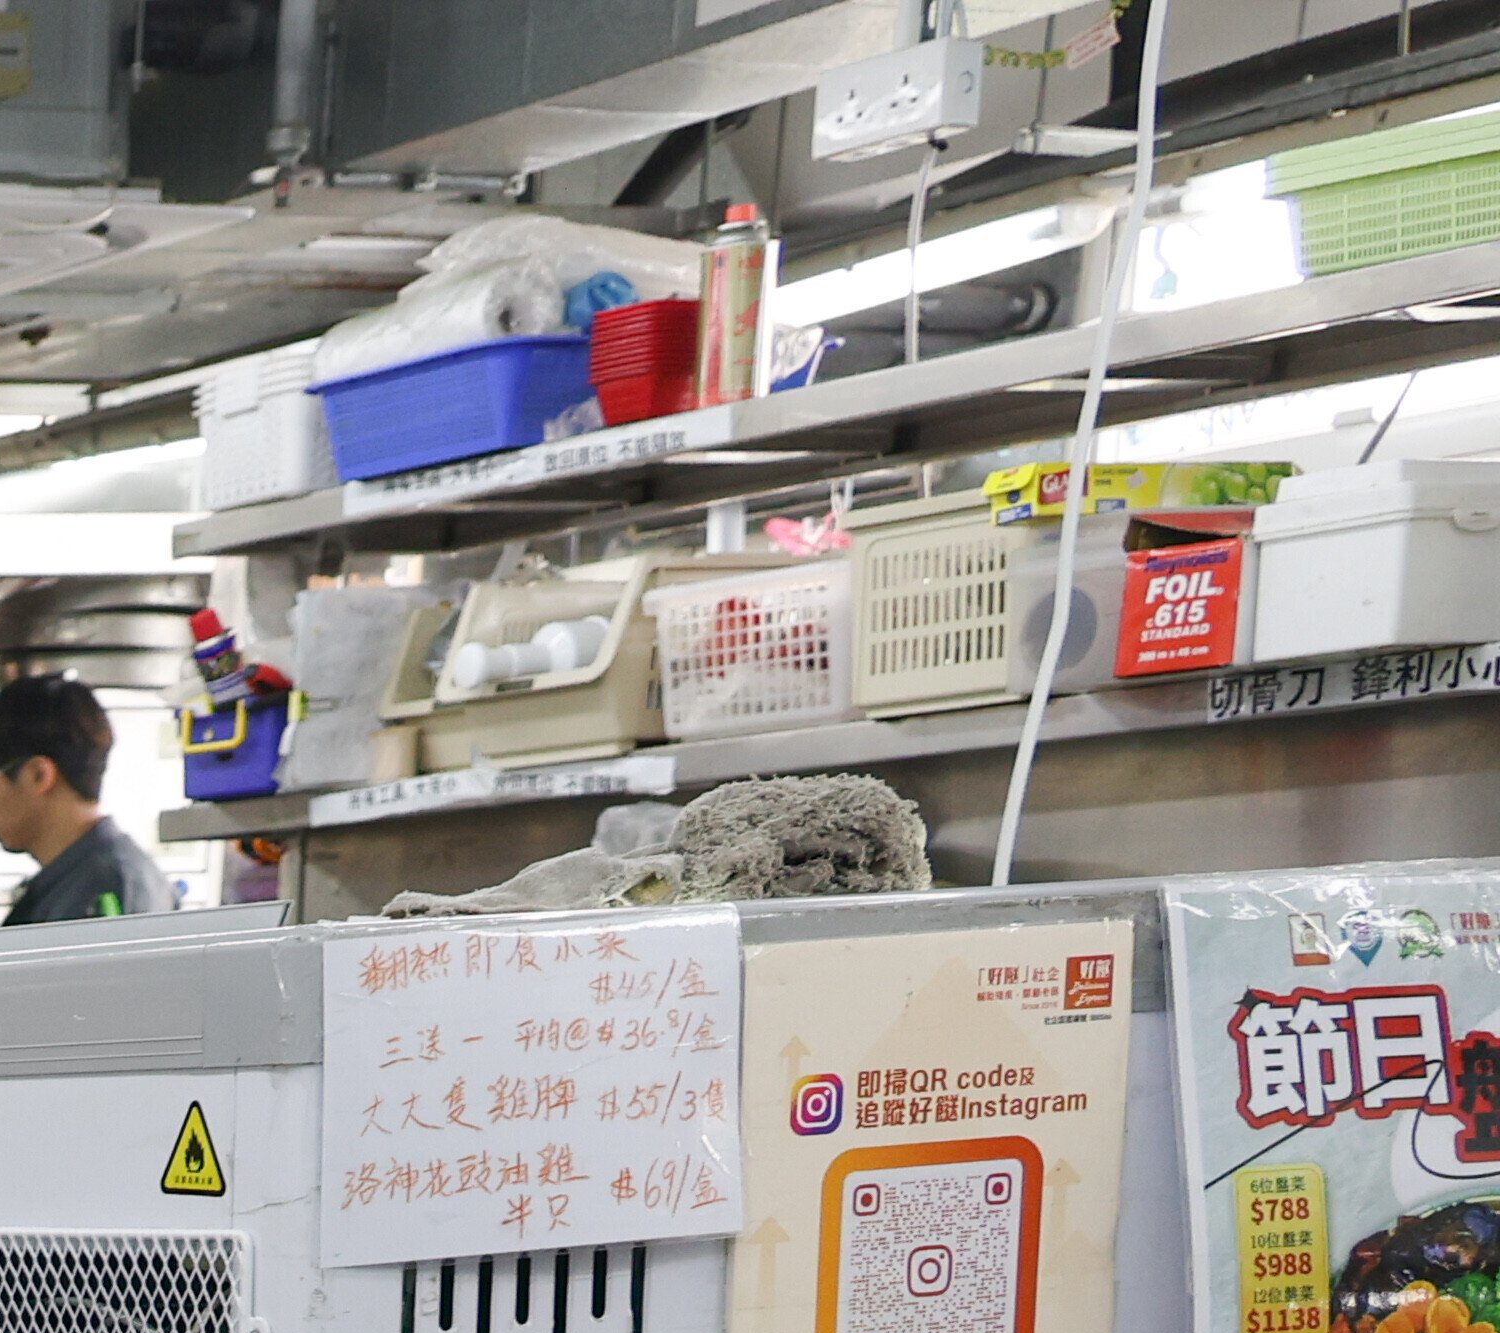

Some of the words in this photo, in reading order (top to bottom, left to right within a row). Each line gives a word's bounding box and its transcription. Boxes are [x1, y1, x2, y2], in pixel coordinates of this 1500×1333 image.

[1210, 666, 1325, 718] 切骨刀
[1251, 1197, 1310, 1226] $788
[1253, 1252, 1312, 1281] $988
